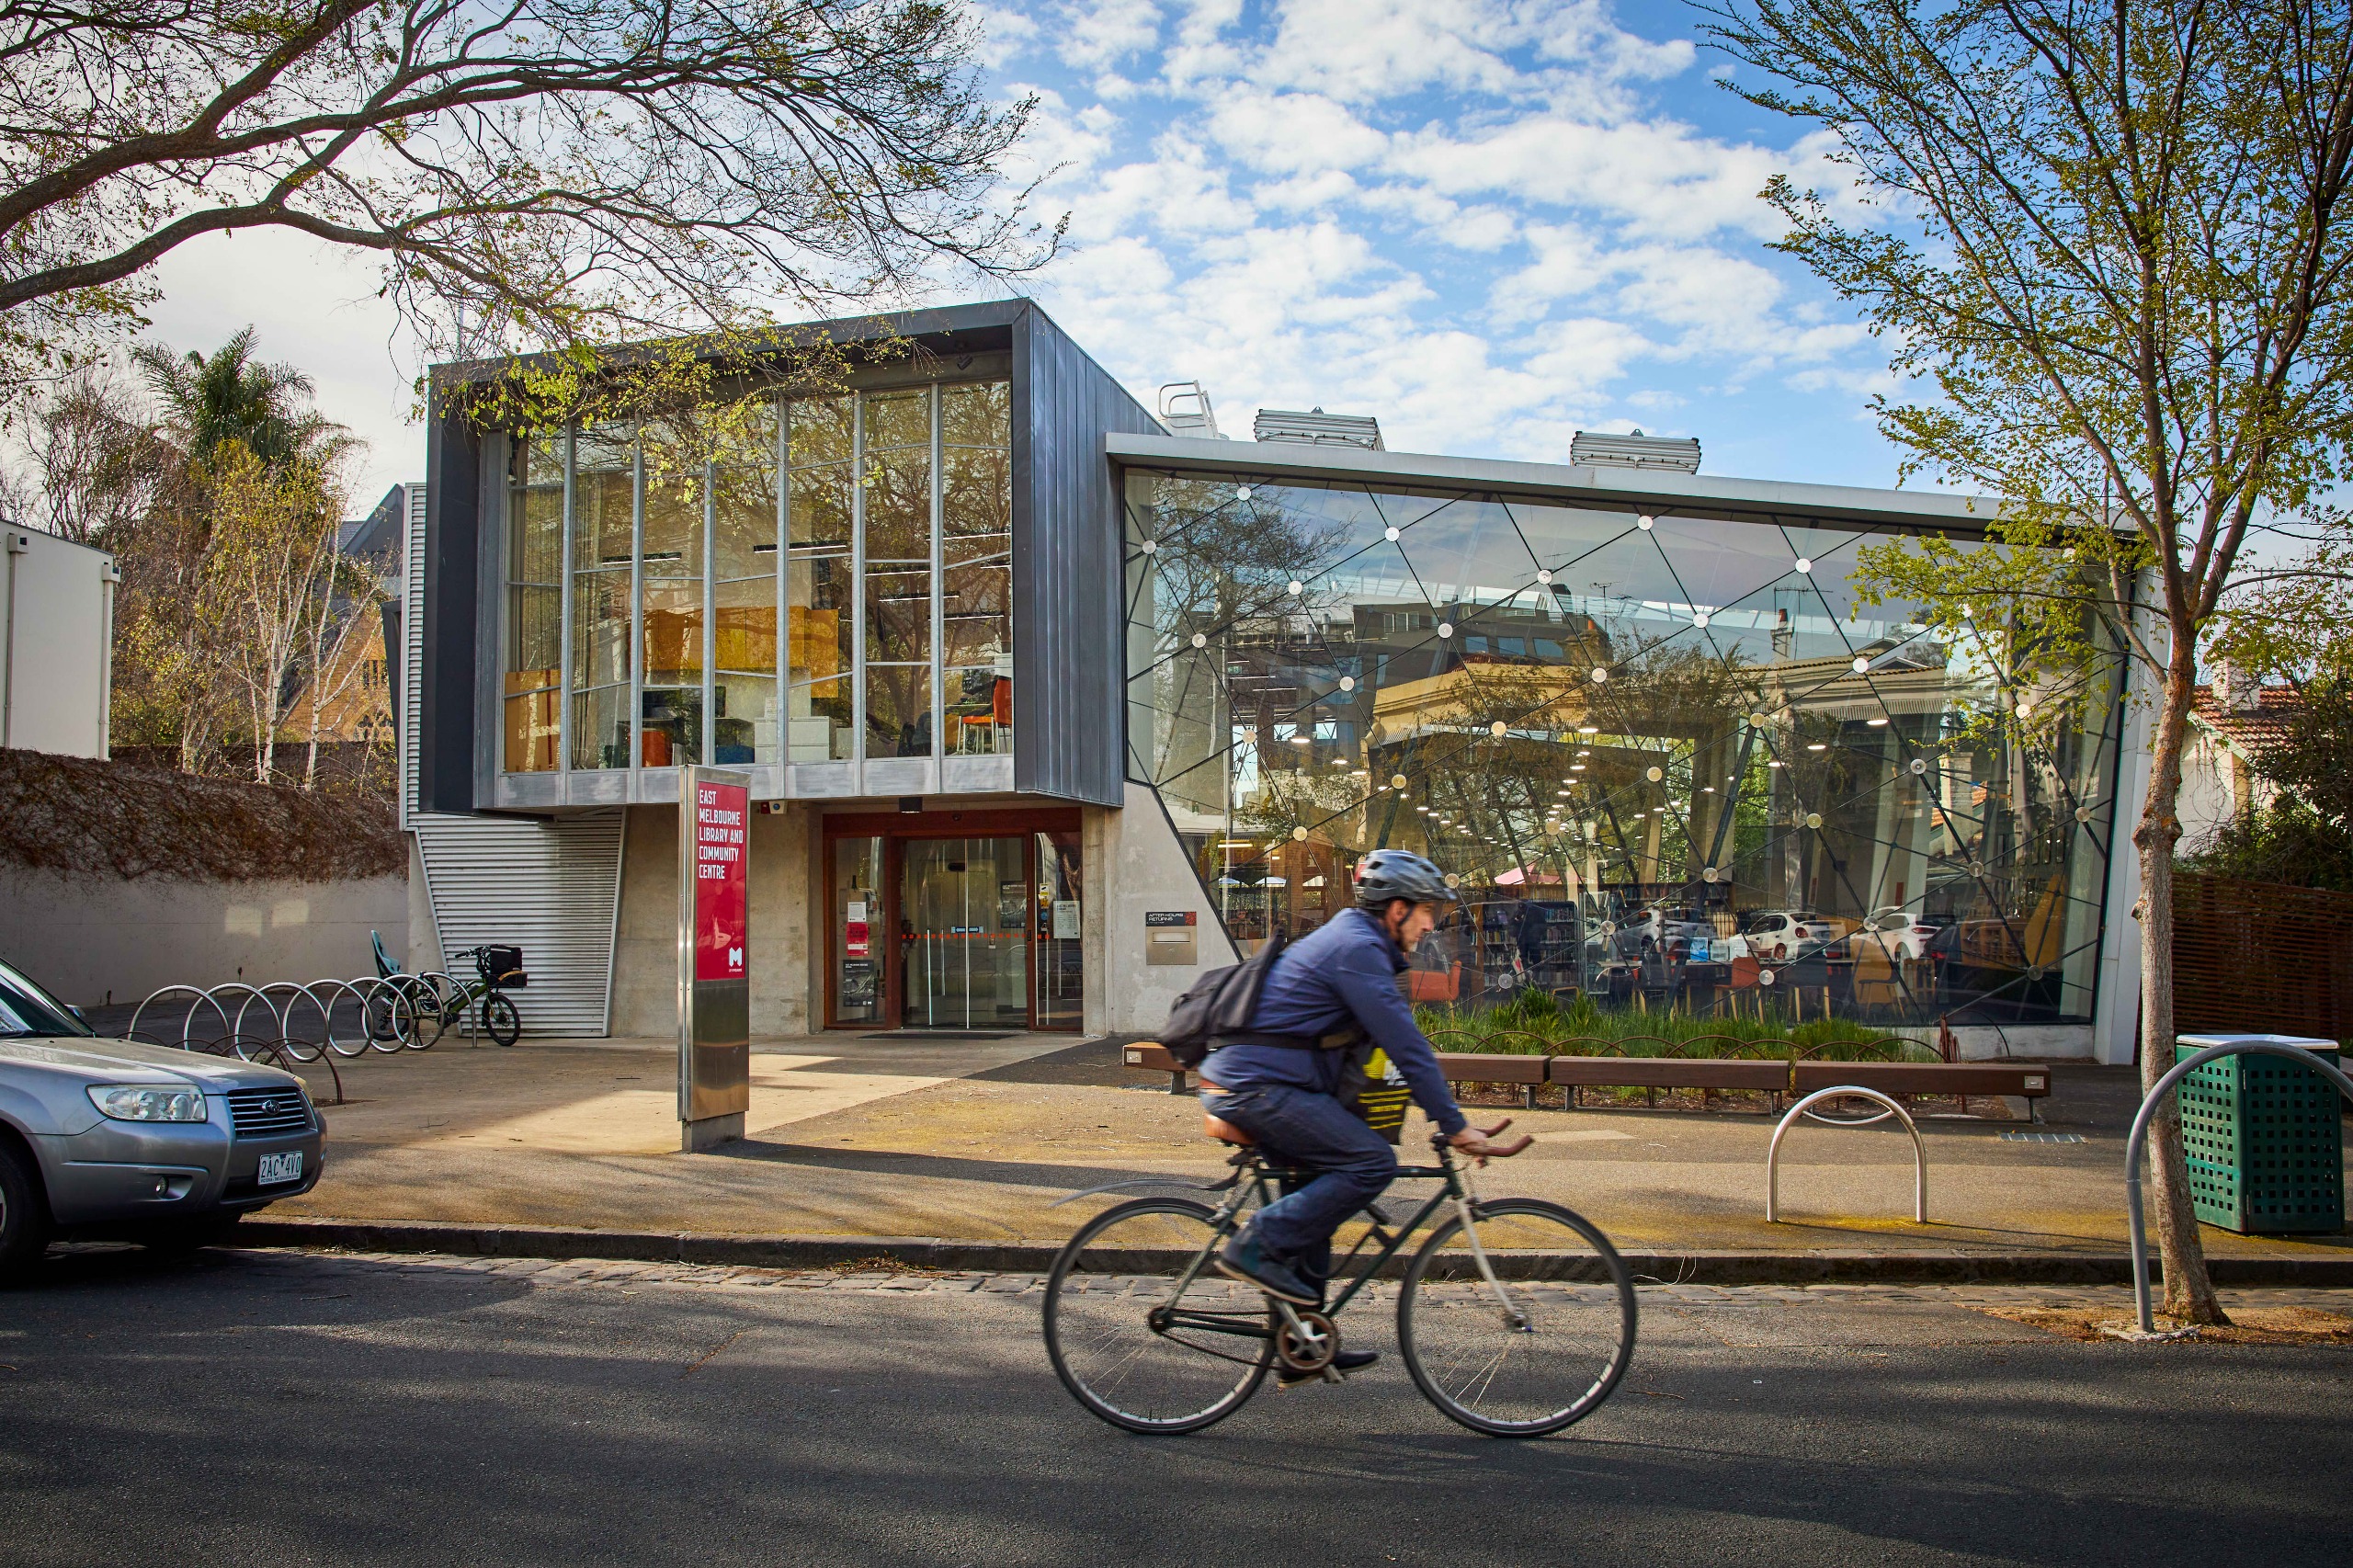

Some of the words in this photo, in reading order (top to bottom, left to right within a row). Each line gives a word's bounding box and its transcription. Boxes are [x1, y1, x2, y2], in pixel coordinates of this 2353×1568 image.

[699, 790, 716, 805] EAST
[699, 808, 740, 825] MELBOURNE
[699, 826, 728, 843] LIBRARY
[730, 829, 744, 844] AND
[699, 846, 739, 862] COMMUNITY
[699, 864, 725, 880] CENTRE
[729, 947, 743, 967] M
[261, 1159, 279, 1177] 2AC
